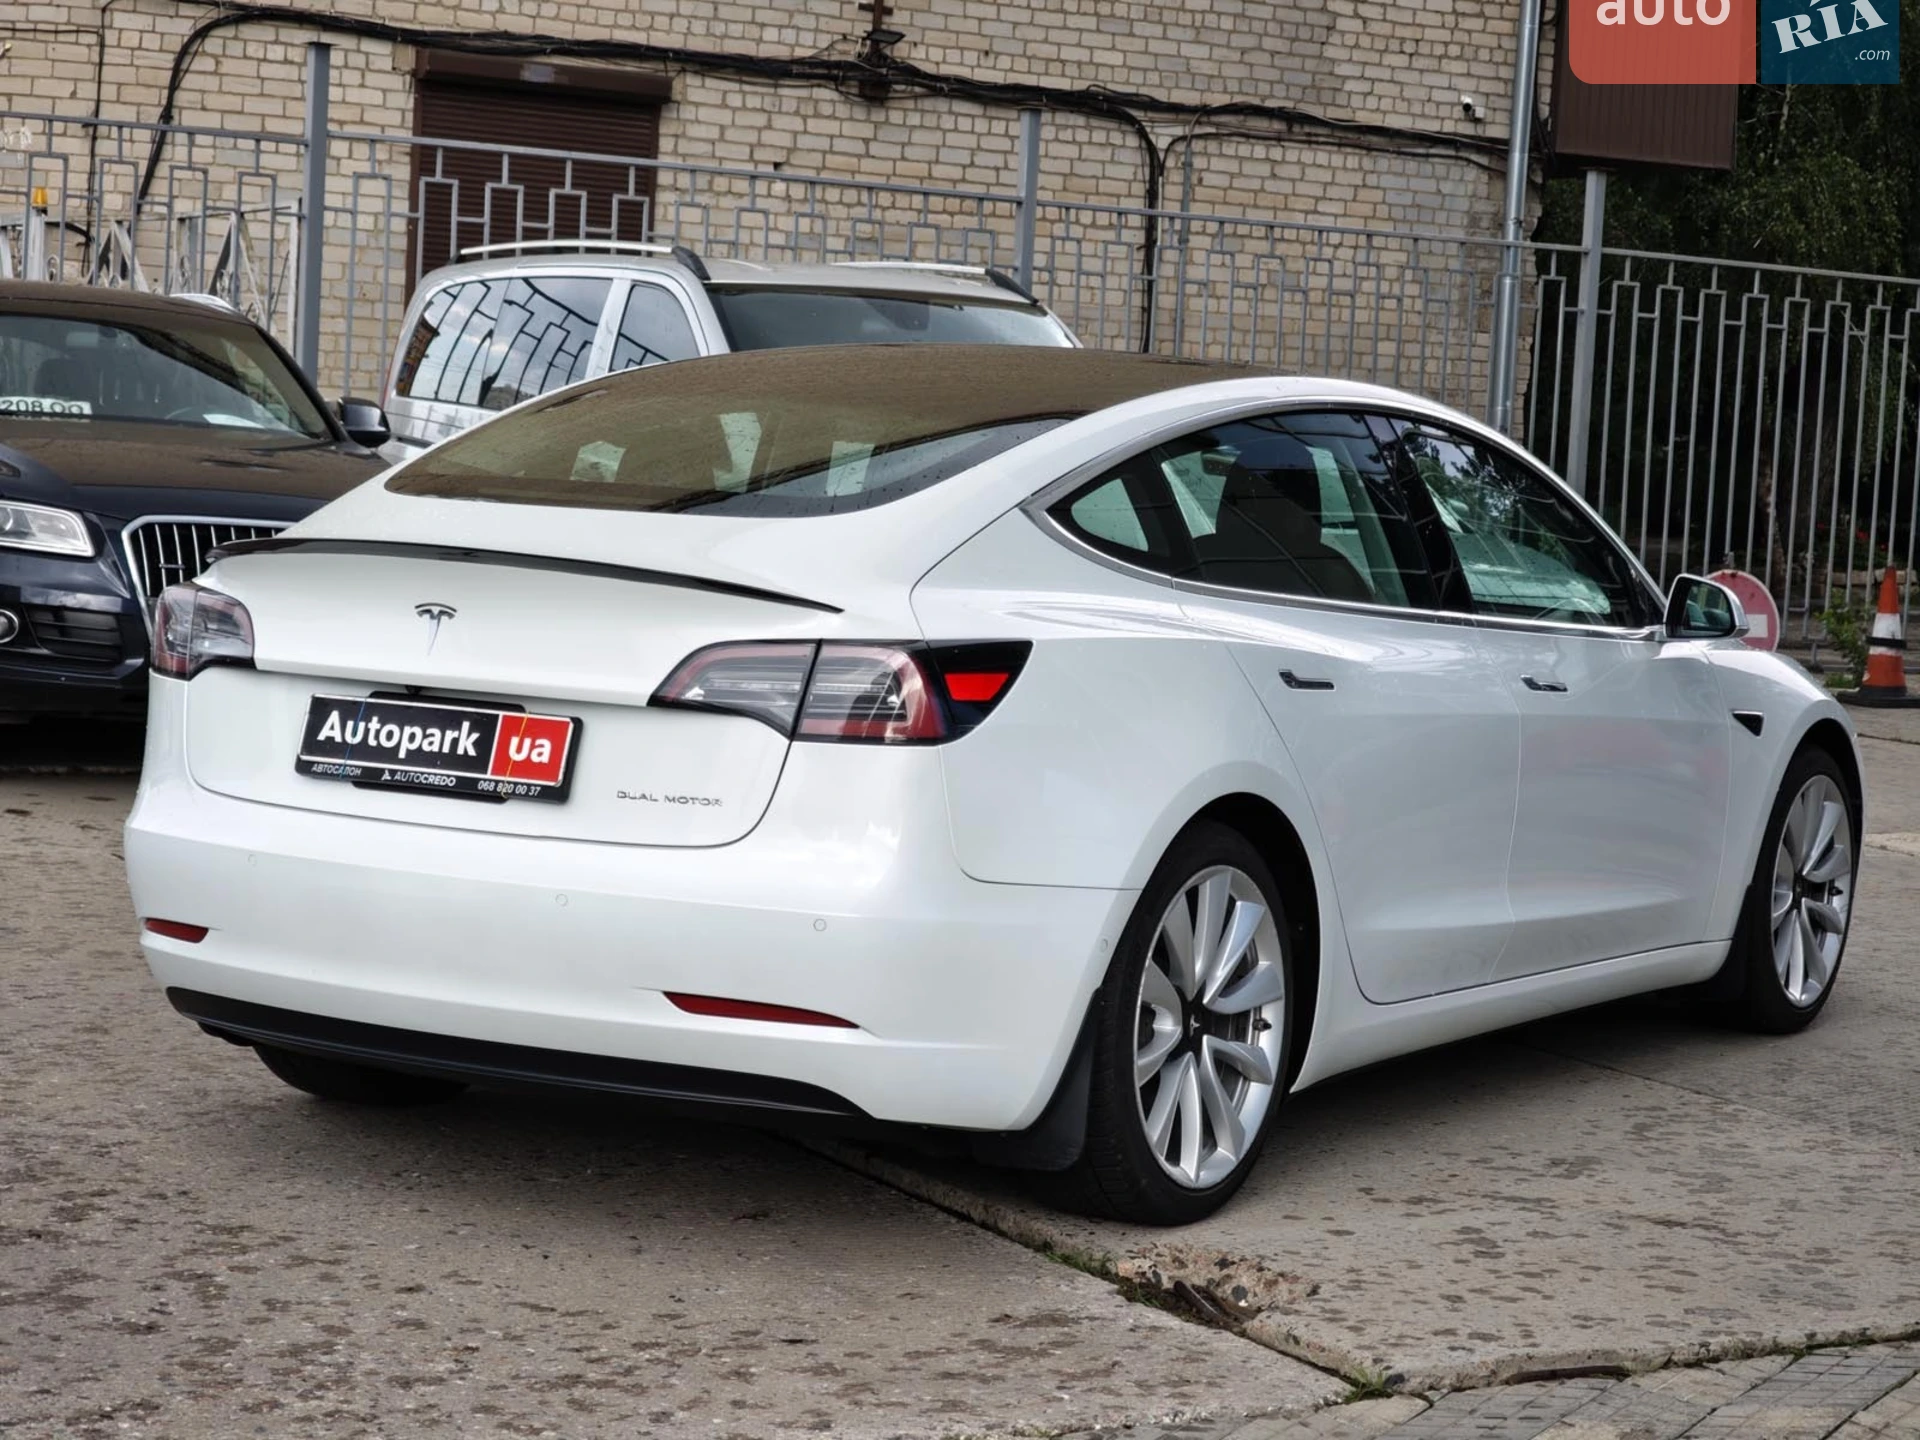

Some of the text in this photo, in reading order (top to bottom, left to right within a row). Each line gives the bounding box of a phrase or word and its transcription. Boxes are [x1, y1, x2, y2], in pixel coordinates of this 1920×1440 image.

[316, 709, 552, 764] Autopark ua
[311, 762, 362, 777] АВТОСАЛОН
[393, 770, 457, 787] AUTOCREDO
[477, 780, 541, 797] 068 820 00 37
[616, 790, 723, 807] DUAL MOTOR
